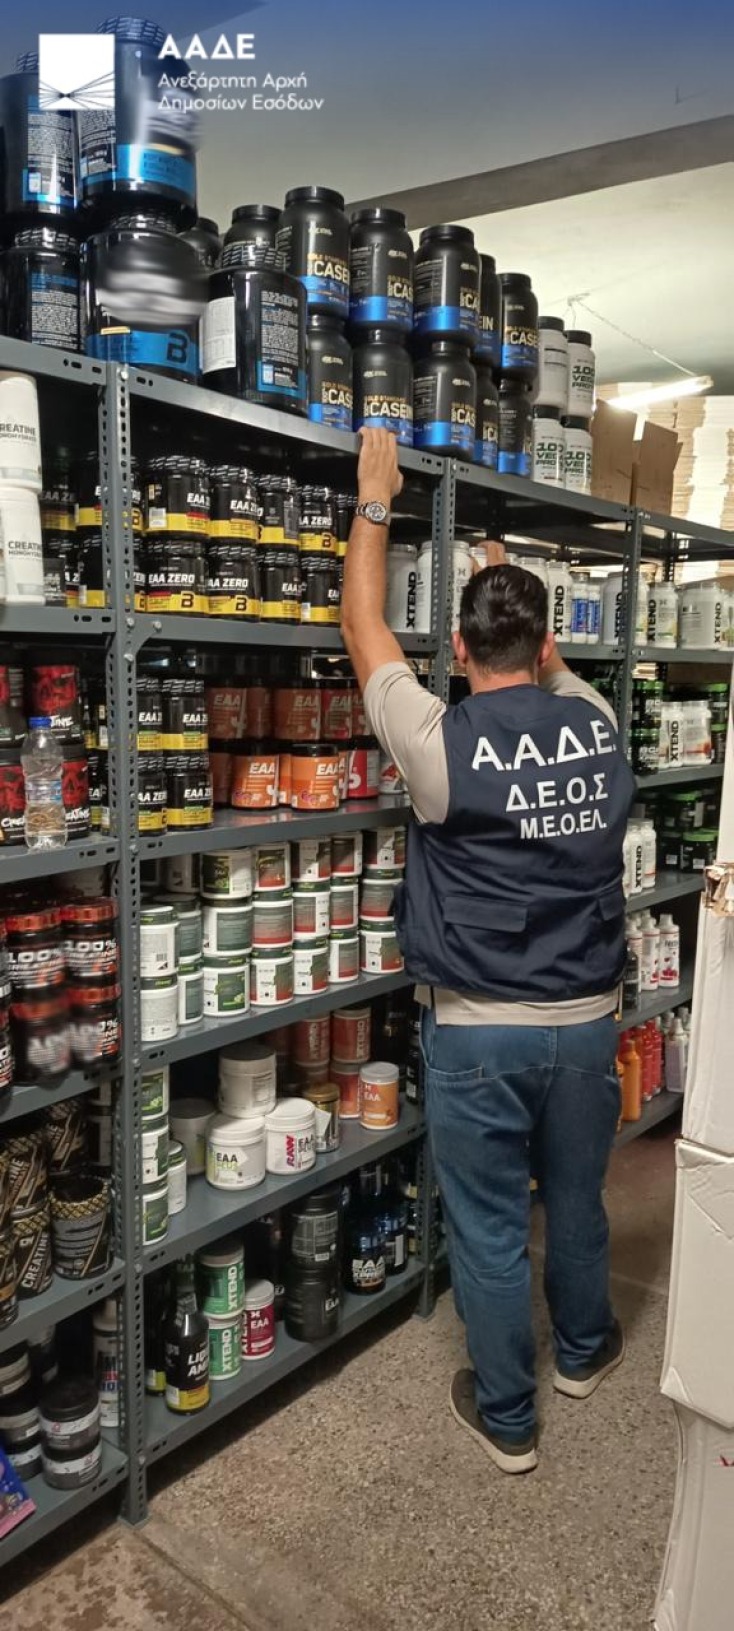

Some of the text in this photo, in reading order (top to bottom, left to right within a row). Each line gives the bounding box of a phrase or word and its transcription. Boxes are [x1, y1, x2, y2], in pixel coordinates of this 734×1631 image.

[167, 573, 195, 584] ZERO
[222, 578, 249, 589] ZERO
[406, 571, 417, 629] XTEND
[553, 585, 565, 637] XTEND
[714, 602, 722, 643] XTEND
[671, 720, 680, 762] XTEND
[216, 1152, 238, 1162] EAA
[227, 1265, 238, 1310] XTEND
[251, 1317, 269, 1329] EAA
[221, 1329, 232, 1373] XTEND
